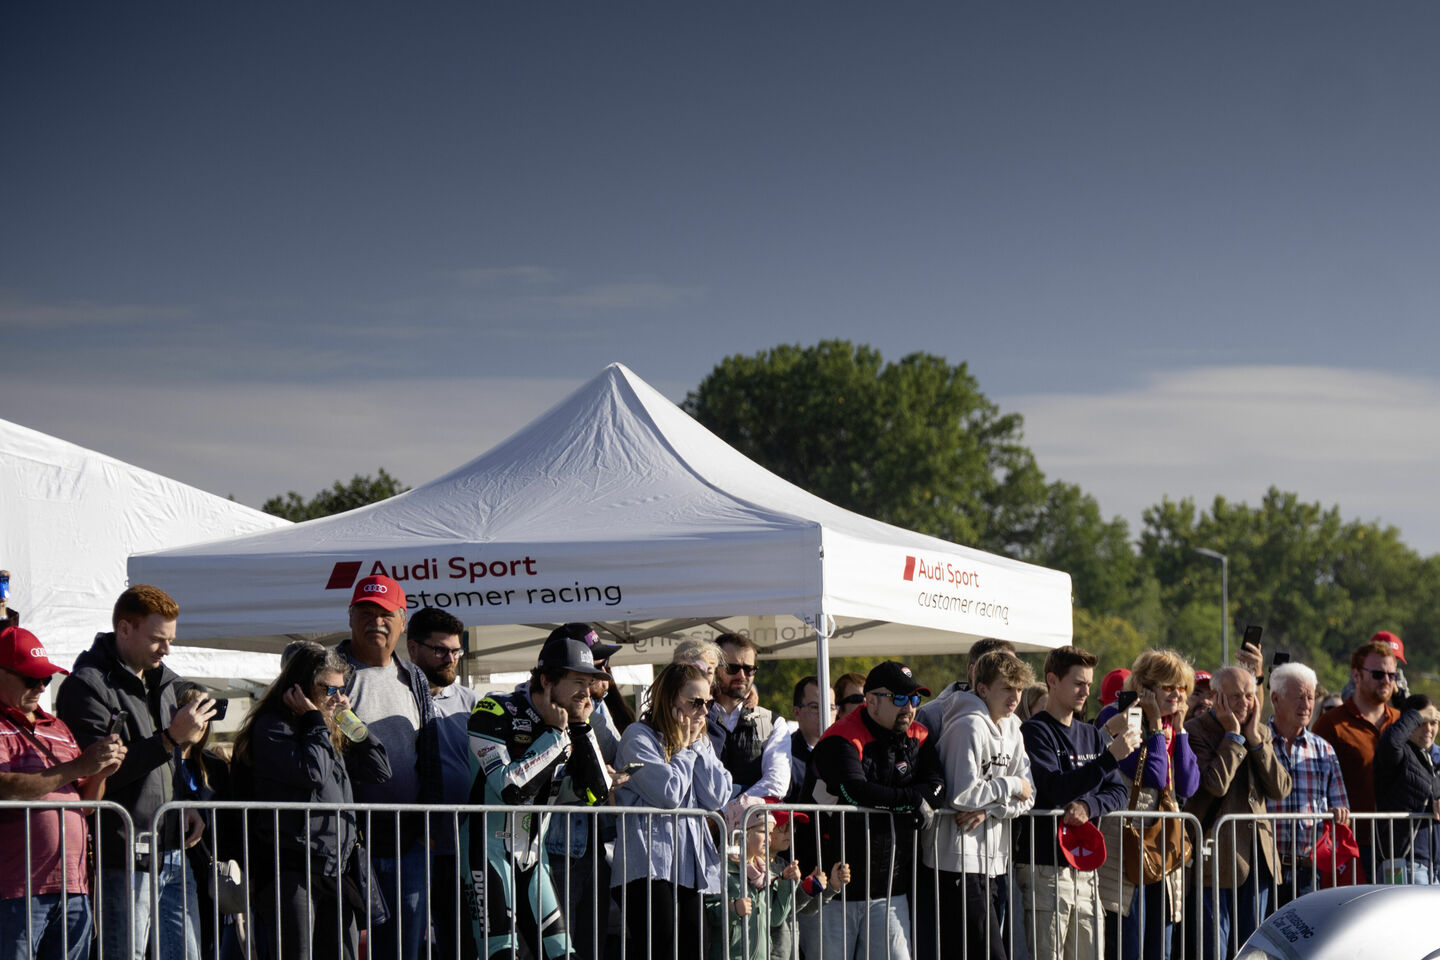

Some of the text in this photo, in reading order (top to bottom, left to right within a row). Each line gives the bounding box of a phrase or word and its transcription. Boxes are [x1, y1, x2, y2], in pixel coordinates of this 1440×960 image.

[369, 556, 537, 583] Audi Sport
[919, 558, 979, 589] Audi Sport
[404, 581, 622, 609] stomer racing
[917, 591, 1009, 626] customer racing
